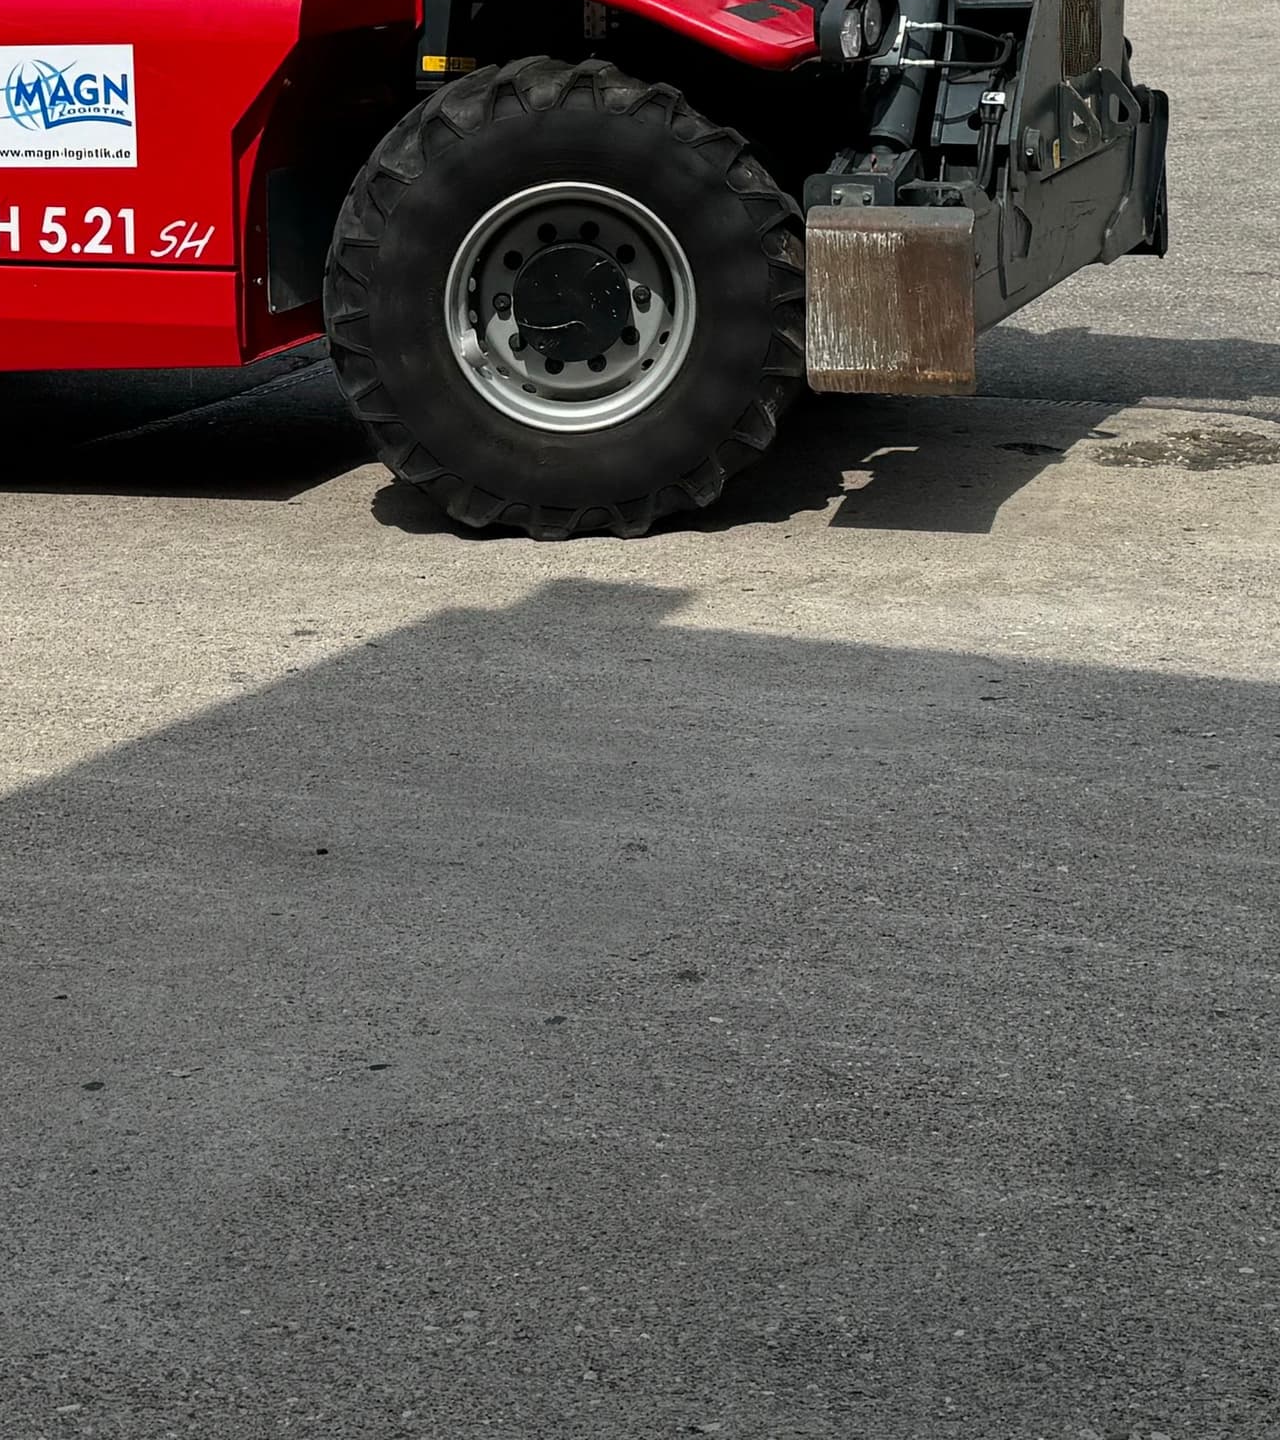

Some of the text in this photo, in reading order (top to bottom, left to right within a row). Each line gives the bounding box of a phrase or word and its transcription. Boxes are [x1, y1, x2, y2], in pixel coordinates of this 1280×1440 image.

[14, 73, 129, 107] MAGN
[39, 206, 135, 255] 5.21
[150, 220, 215, 259] SH
